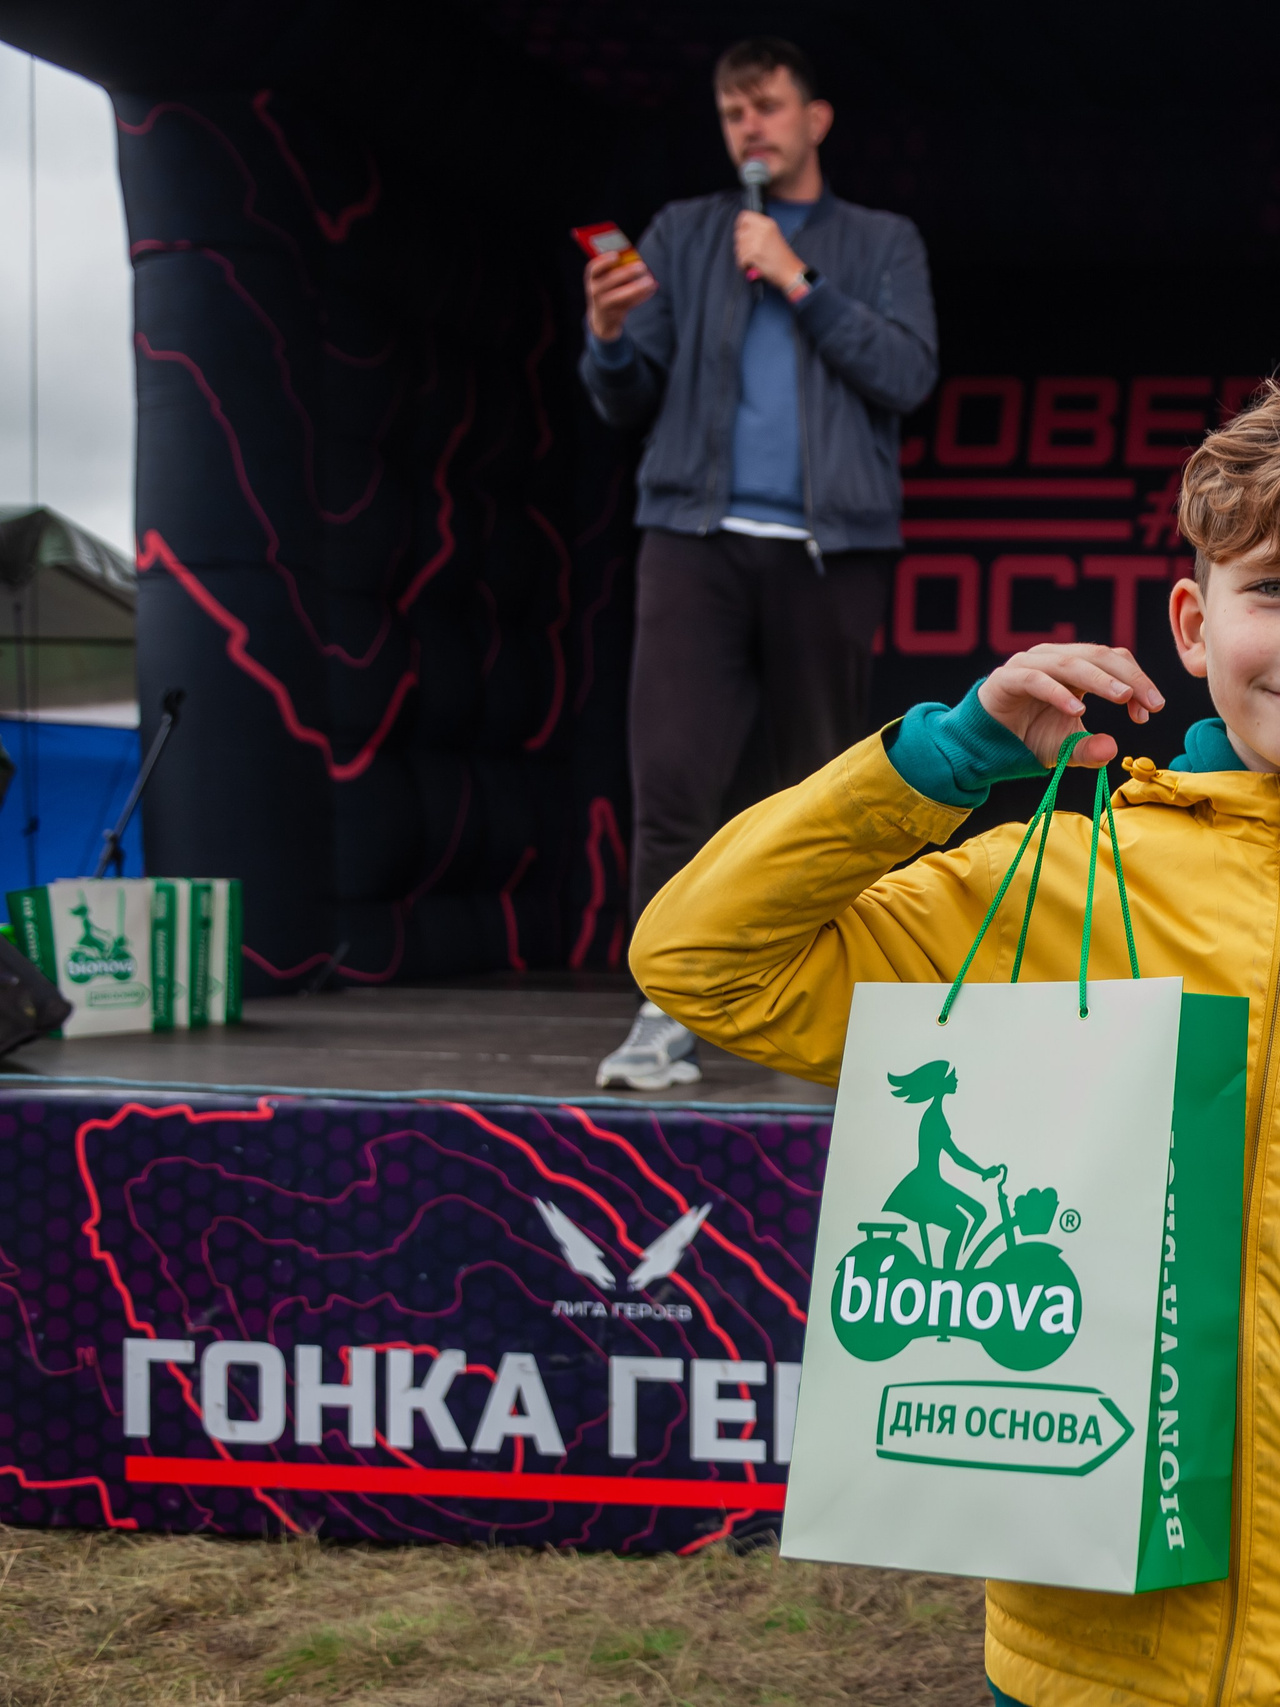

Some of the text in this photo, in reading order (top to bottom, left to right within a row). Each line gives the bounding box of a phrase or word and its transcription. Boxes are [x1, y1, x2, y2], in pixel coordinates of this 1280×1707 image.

[551, 1300, 693, 1322] ЛИГА ГЕРОЕВ
[839, 1254, 1076, 1335] bionova
[123, 1337, 567, 1456] ГОНКА
[889, 1401, 1103, 1446] ДНЯ ОСНОВА
